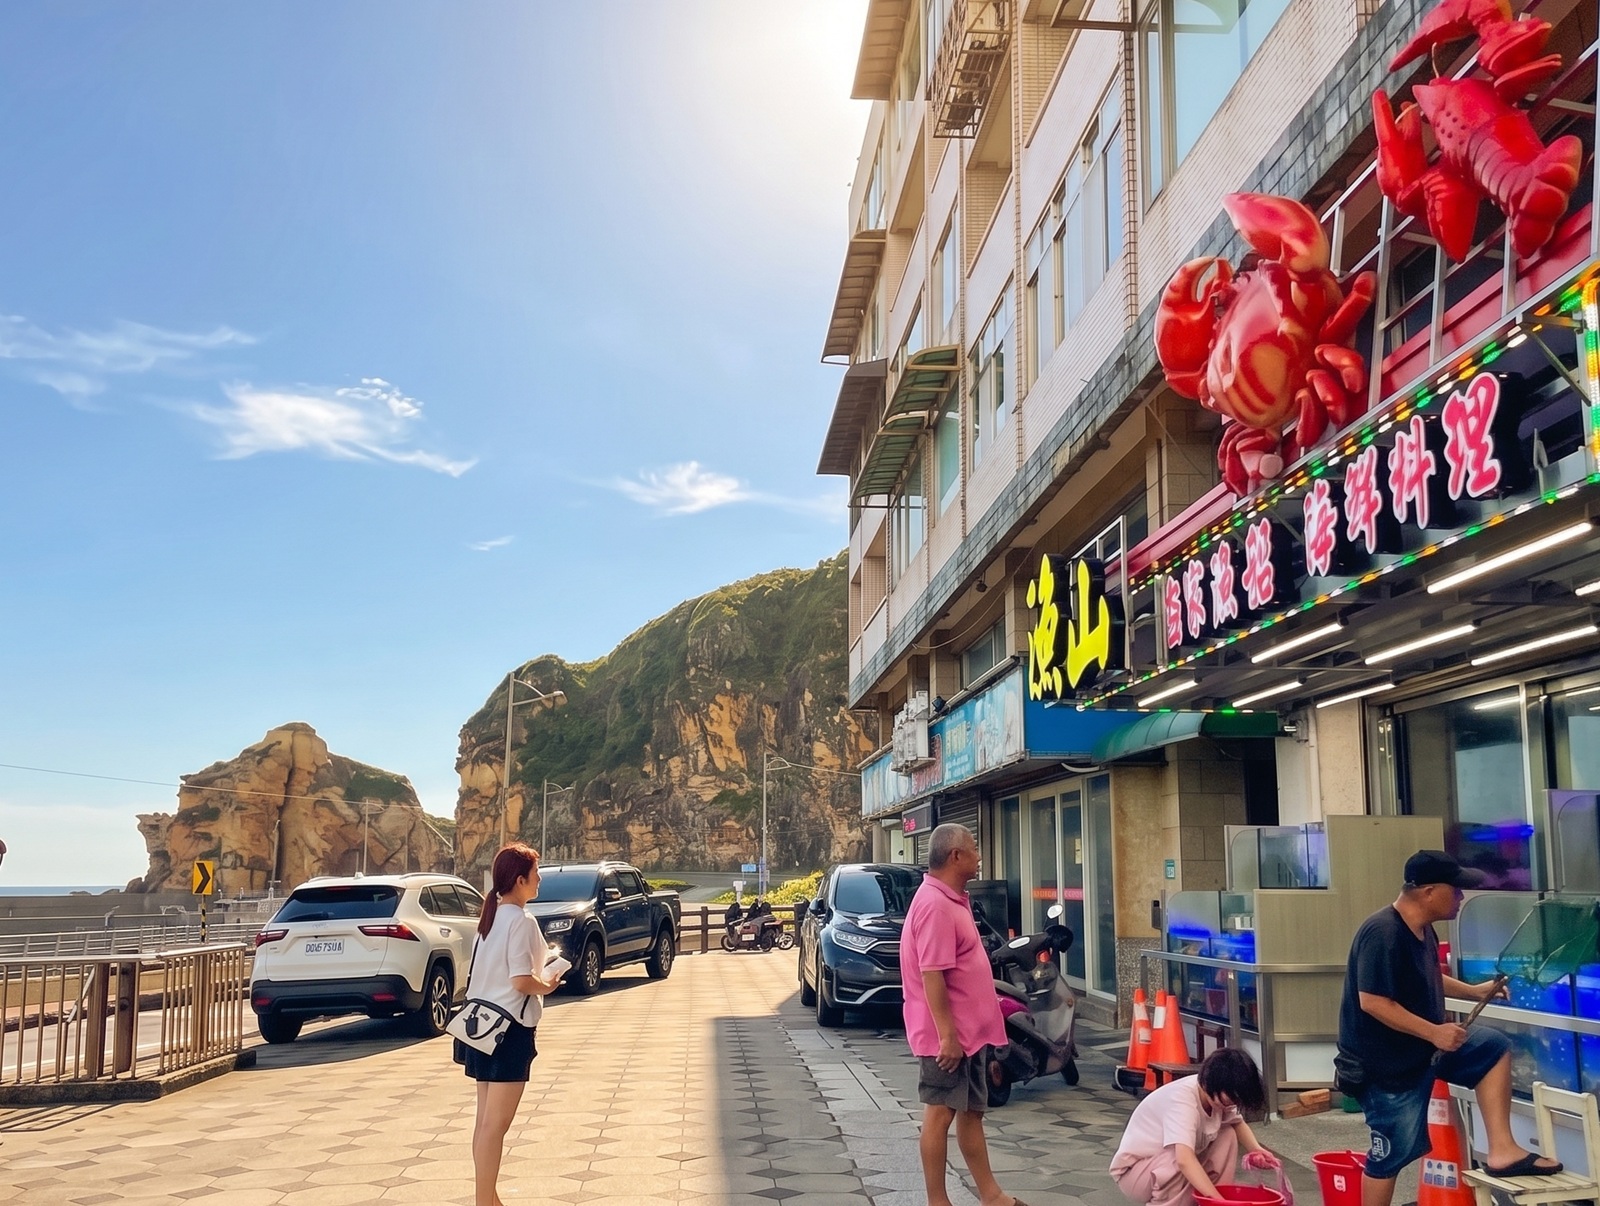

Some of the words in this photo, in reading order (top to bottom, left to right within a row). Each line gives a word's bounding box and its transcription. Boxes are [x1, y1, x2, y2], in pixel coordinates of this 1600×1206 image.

[1303, 372, 1501, 577] 海鮮料理
[1026, 553, 1110, 701] 漁山
